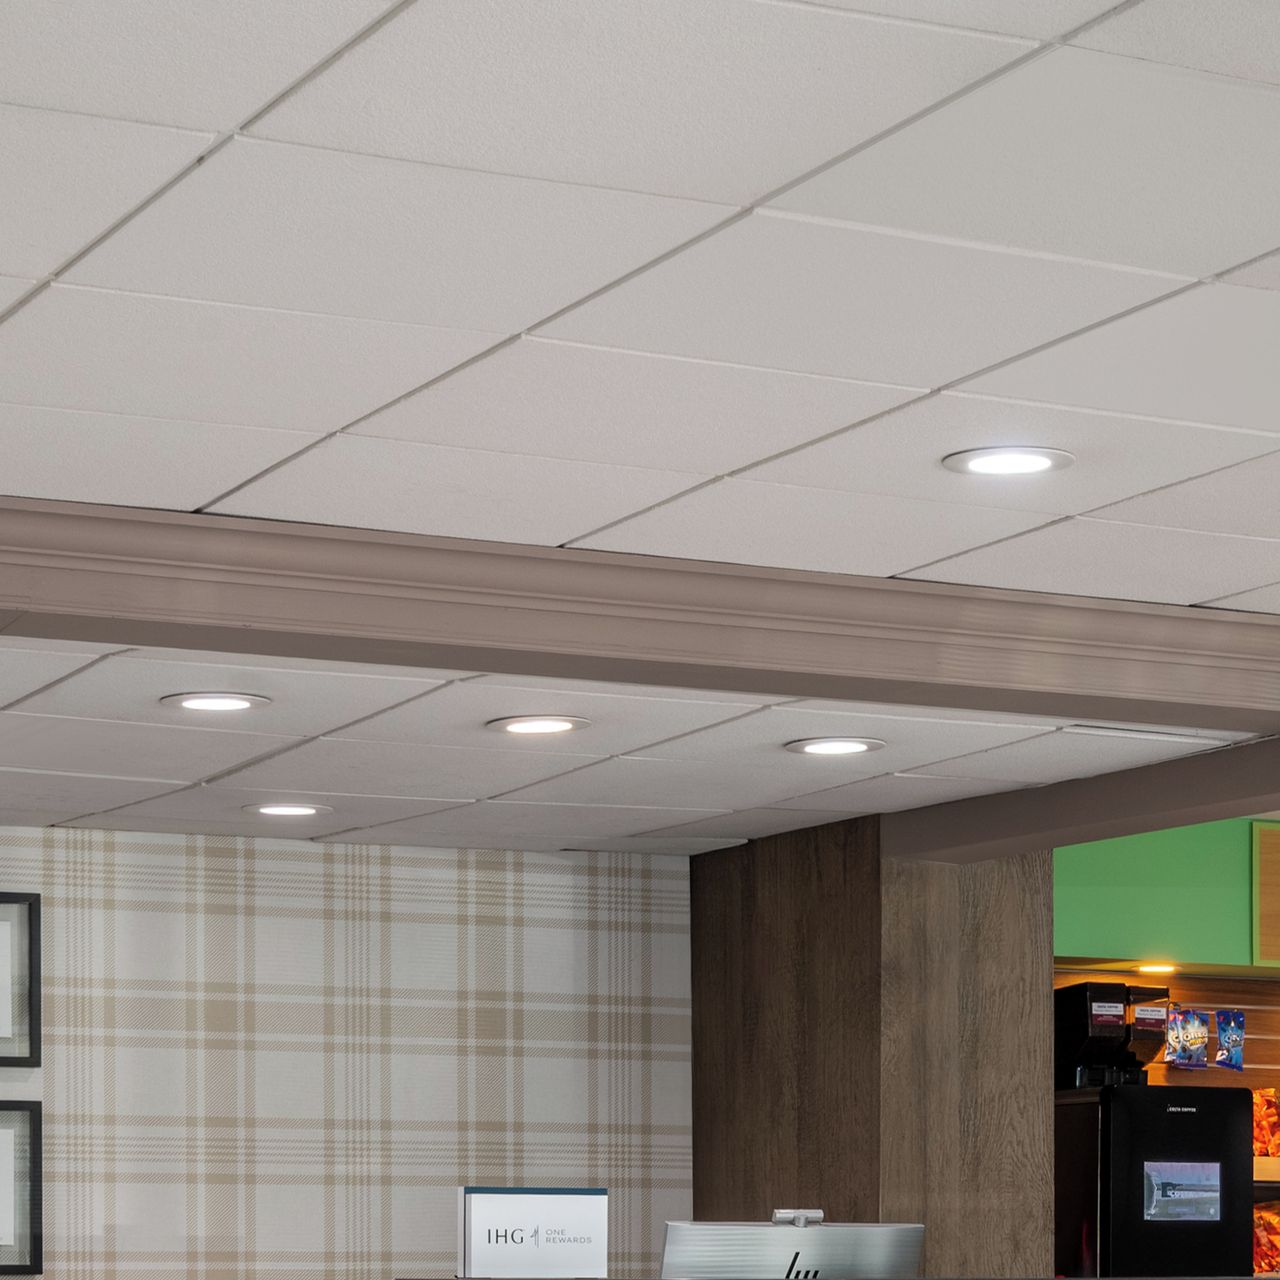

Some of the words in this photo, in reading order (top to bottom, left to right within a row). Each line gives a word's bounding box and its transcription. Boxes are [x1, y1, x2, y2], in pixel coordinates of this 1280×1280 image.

[545, 1228, 567, 1236] ONE
[487, 1228, 524, 1245] IHG
[545, 1236, 593, 1244] REWARDS
